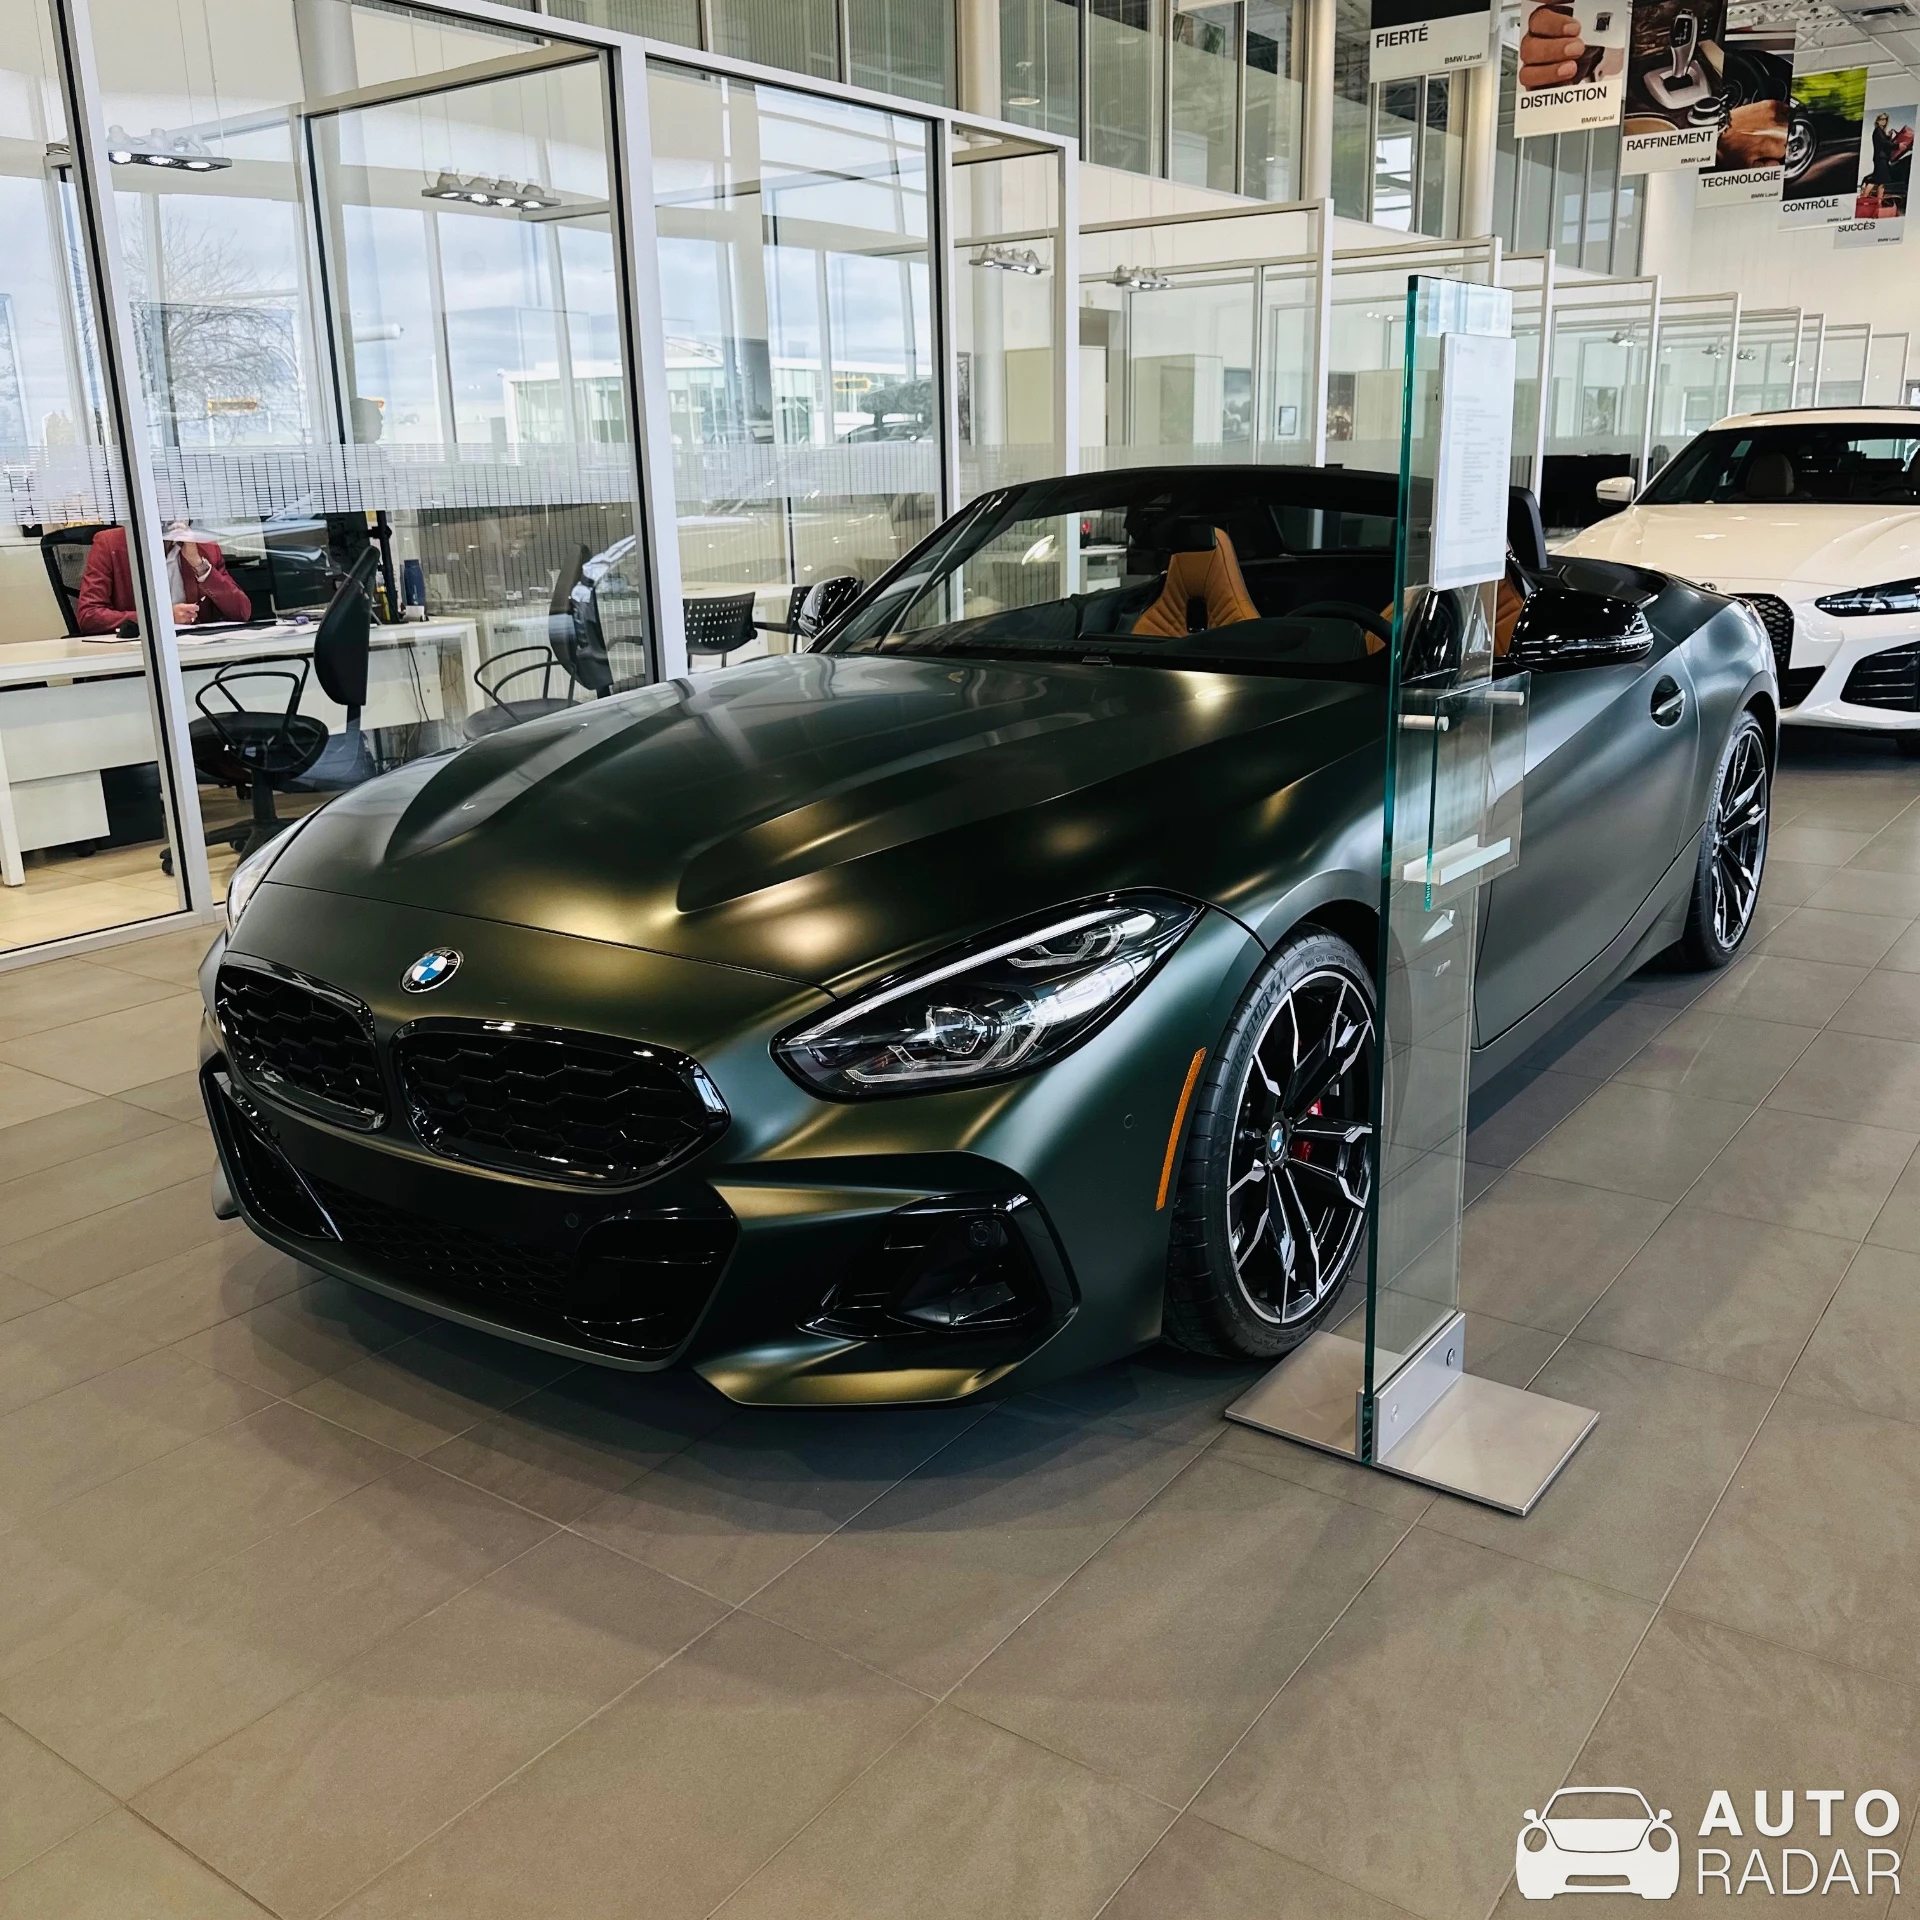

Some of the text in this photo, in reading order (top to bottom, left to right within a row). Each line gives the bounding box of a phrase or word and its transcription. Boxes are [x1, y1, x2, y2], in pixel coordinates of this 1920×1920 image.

[1376, 23, 1428, 48] FIERTÉ
[1444, 53, 1482, 64] BMW Laval
[1521, 86, 1607, 109] DISTINCTION
[1581, 114, 1614, 124] BMW Laval
[1626, 131, 1714, 151] RAFFINEMENT
[1697, 155, 1711, 163] Laval
[1701, 171, 1781, 188] TECHNOLOGIE
[1782, 198, 1839, 213] CONTRÔLE
[1837, 221, 1876, 233] SUCCÈS
